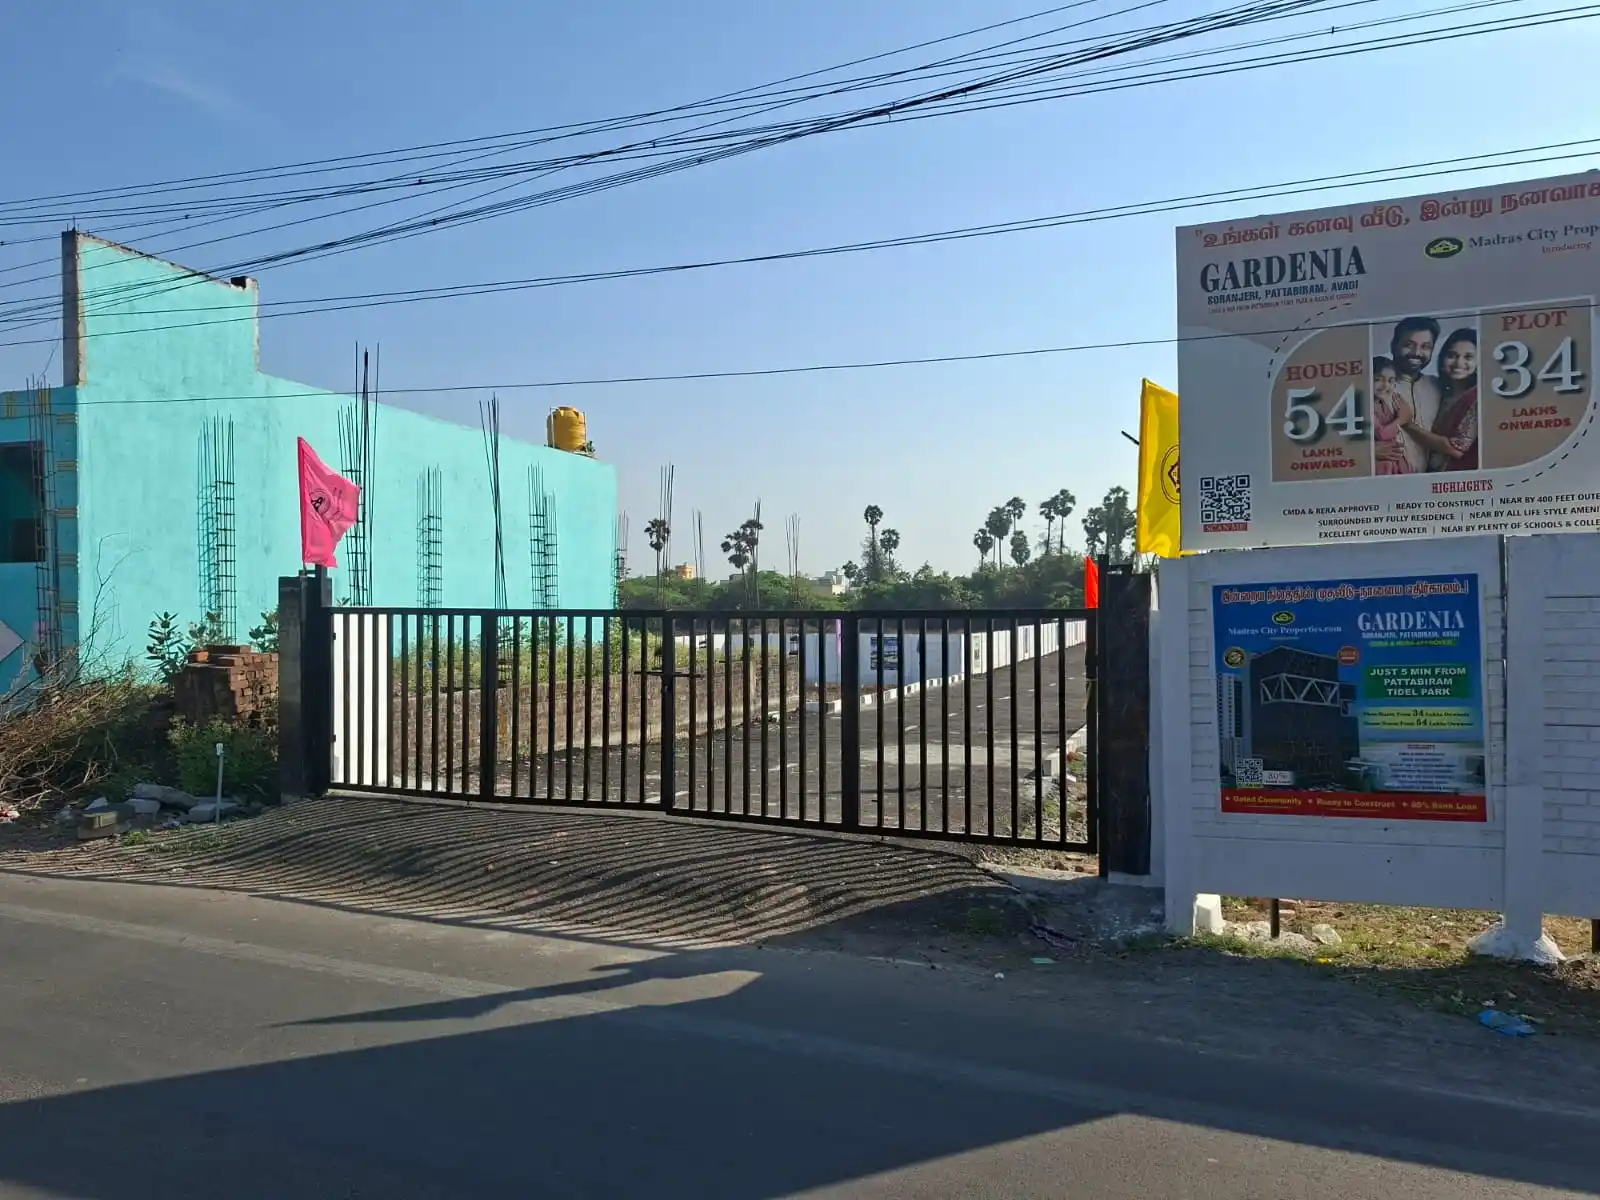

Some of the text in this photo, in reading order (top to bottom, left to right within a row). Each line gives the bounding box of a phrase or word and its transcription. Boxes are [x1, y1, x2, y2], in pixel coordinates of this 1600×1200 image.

[1288, 214, 1353, 234] கனவு
[1361, 205, 1410, 228] வீடு,
[1420, 197, 1493, 221] இன்று
[1469, 234, 1523, 249] Madras
[1527, 226, 1558, 241] City
[1200, 245, 1367, 293] GARDENIA
[1331, 279, 1359, 292] AVADI
[1501, 310, 1567, 331] PLOT
[1286, 360, 1363, 381] HOUSE
[1492, 336, 1583, 397] 34
[1283, 382, 1365, 441] 54
[1511, 405, 1558, 418] LAKHS
[1499, 417, 1571, 431] ONWARDS
[1302, 446, 1343, 459] LAKHS
[1290, 458, 1356, 471] ONWARDS
[1431, 479, 1494, 494] HIGHLIGHTS
[1283, 508, 1307, 516] CMDA
[1316, 507, 1336, 515] RERA
[1338, 504, 1380, 513] APPROVED
[1396, 502, 1422, 510] READY
[1425, 501, 1435, 509] TO
[1437, 499, 1484, 508] CONSTRUCT
[1500, 497, 1522, 505] NEAR
[1537, 495, 1553, 503] 400
[1555, 494, 1575, 502] FEET
[1318, 517, 1372, 527] SURROUNDED
[1386, 515, 1409, 523] FULLY
[1411, 513, 1456, 522] RESIDENCE
[1469, 511, 1492, 519] NEAR
[1507, 509, 1521, 517] ALL
[1524, 508, 1540, 516] LIFE
[1543, 507, 1568, 515] STYLE
[1319, 530, 1360, 539] EXCELLENT
[1363, 528, 1397, 536] GROUND
[1400, 527, 1427, 535] WATER
[1441, 525, 1463, 533] NEAR
[1465, 524, 1475, 532] BY
[1478, 522, 1508, 531] PLENTY
[1524, 520, 1562, 529] SCHOOLS
[1357, 609, 1465, 631] GARDENIA
[1228, 626, 1259, 636] Madras
[1260, 625, 1277, 636] City
[1369, 667, 1466, 676] JUST 5 MIN FROM
[1384, 678, 1453, 686] PATTABIRAM
[1387, 688, 1418, 696] TIDEL
[1412, 708, 1423, 716] 34
